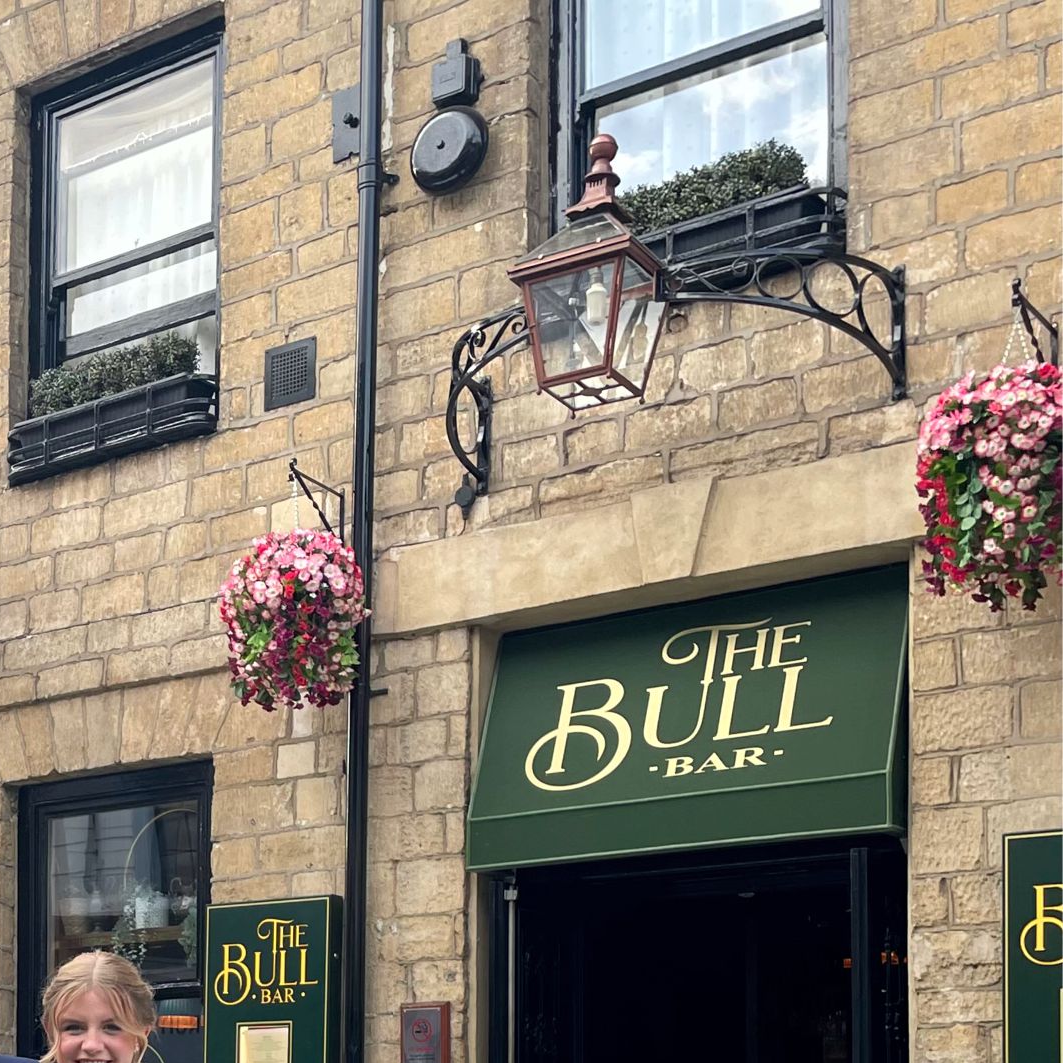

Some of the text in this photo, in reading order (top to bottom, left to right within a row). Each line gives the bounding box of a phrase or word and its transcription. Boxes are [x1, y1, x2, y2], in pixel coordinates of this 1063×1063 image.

[662, 617, 811, 685] THE
[524, 666, 833, 791] BULL
[257, 918, 308, 950] THE
[214, 943, 318, 1005] BULL
